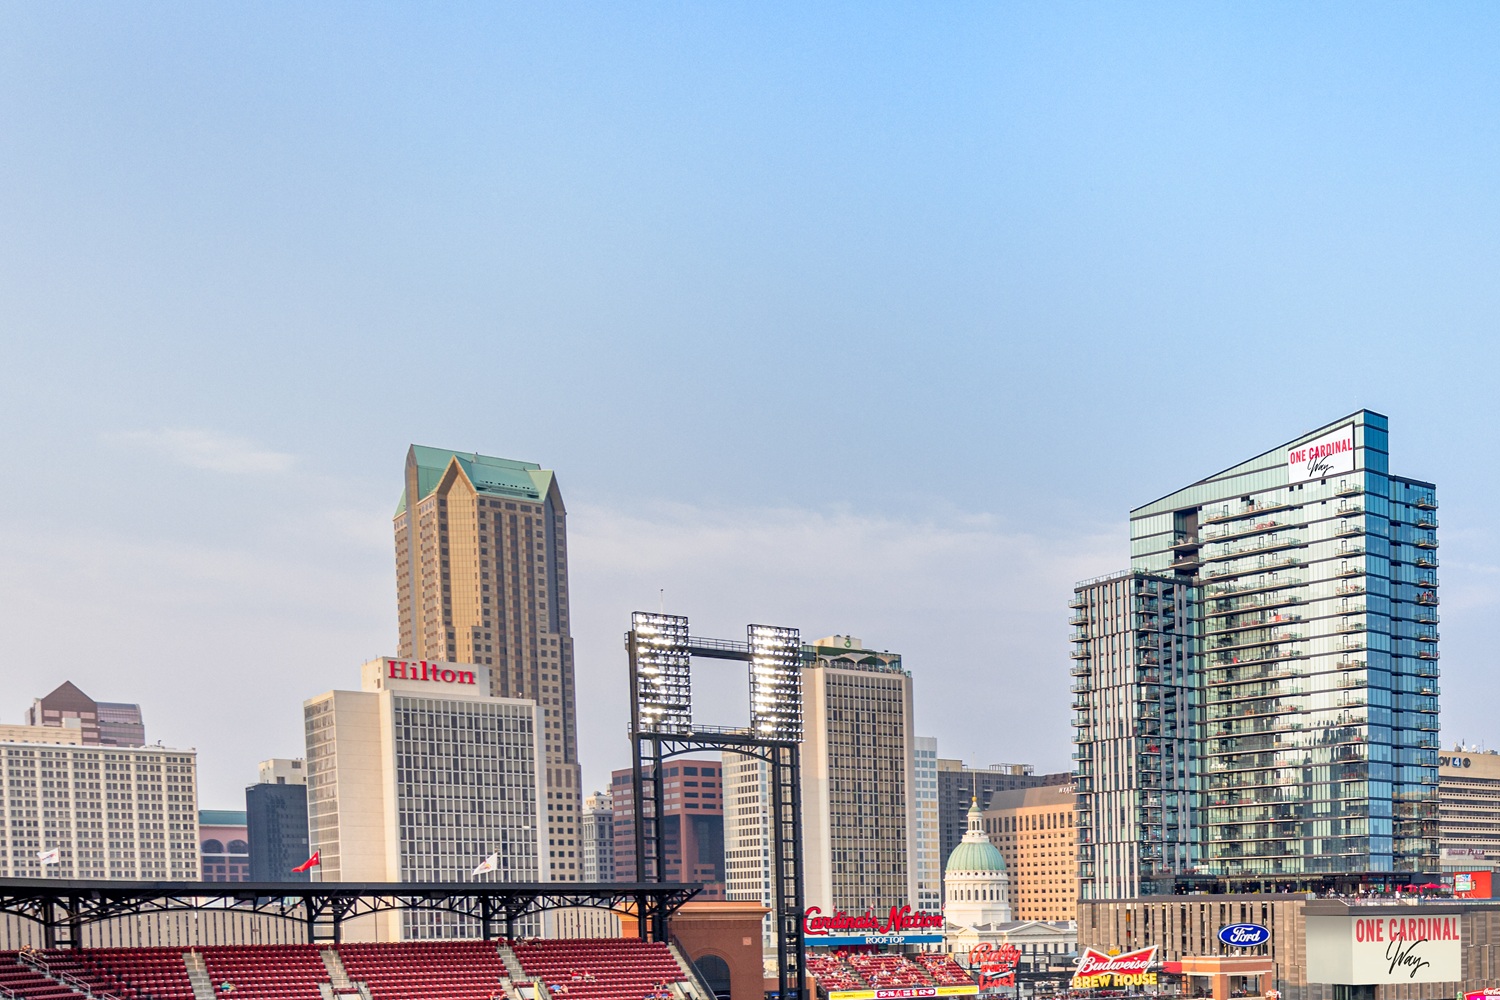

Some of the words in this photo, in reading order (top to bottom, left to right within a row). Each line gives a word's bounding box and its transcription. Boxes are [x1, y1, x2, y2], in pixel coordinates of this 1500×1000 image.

[1290, 450, 1306, 464] ONE
[1308, 438, 1353, 460] CARDINAL
[1306, 454, 1334, 477] Way
[386, 658, 476, 686] Hilton
[803, 906, 879, 935] Cardinals
[878, 904, 944, 934] Nation
[1356, 918, 1384, 942] ONE
[1388, 917, 1460, 942] CARDINAL
[865, 936, 905, 944] ROOFTOP
[1229, 926, 1261, 942] Ford
[968, 942, 1022, 967] Bally
[1072, 956, 1156, 973] Budweiser
[1386, 932, 1430, 978] Way
[1073, 976, 1112, 990] BREW
[1114, 973, 1157, 987] HOUSE
